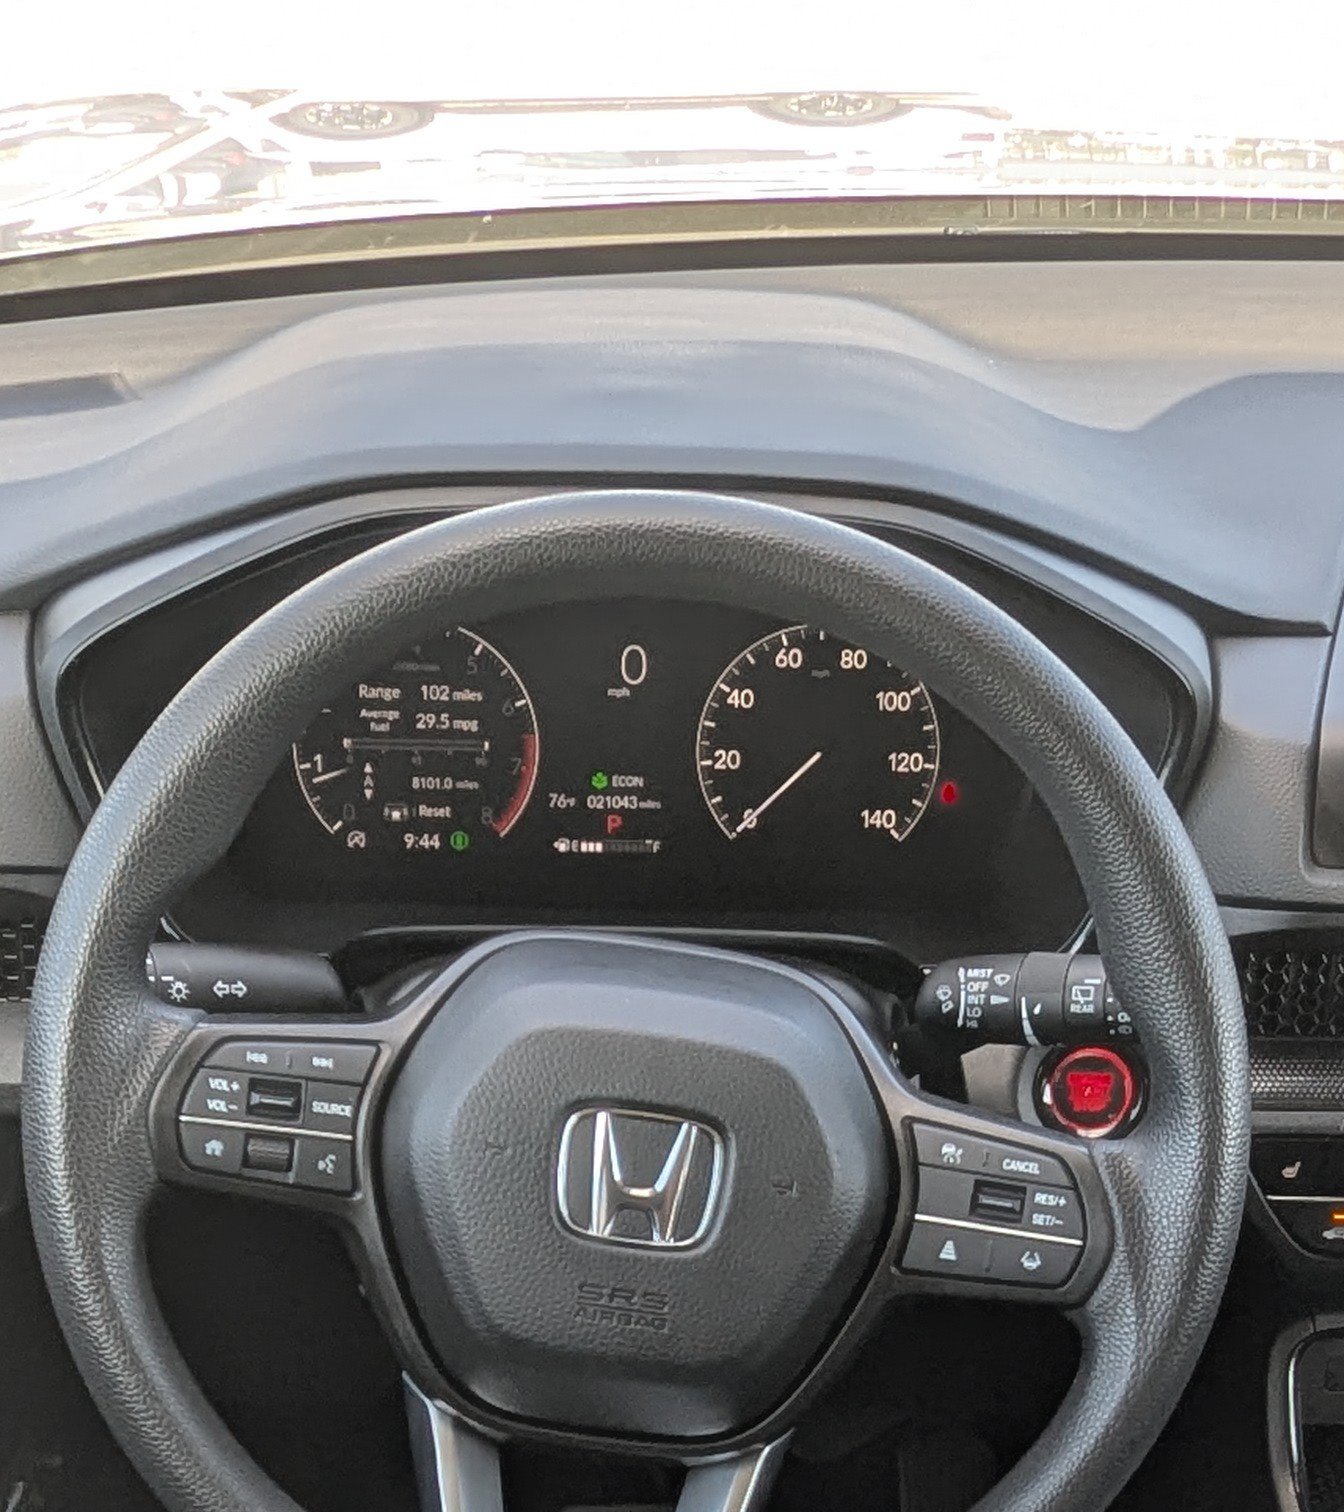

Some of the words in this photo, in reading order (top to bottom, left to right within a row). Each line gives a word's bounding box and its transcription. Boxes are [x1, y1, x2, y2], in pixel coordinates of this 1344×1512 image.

[621, 644, 647, 685] 0
[775, 648, 803, 669] 60
[840, 649, 868, 670] 80
[359, 684, 401, 701] Range
[420, 685, 450, 701] 102
[452, 688, 483, 702] miles
[607, 687, 630, 699] mph
[727, 688, 755, 709] 40
[876, 691, 911, 712] 100
[359, 708, 400, 721] Average
[416, 713, 450, 730] 29.5
[453, 719, 479, 733] mpg
[370, 721, 390, 732] fuel
[714, 750, 741, 770] 20
[888, 753, 924, 773] 120
[412, 776, 453, 790] 8101.0
[612, 775, 644, 787] ECON
[586, 795, 638, 809] 021043
[419, 804, 451, 819] Reset
[861, 809, 896, 828] 140
[607, 814, 623, 834] P
[404, 833, 441, 850] 9:44
[967, 981, 989, 992] OFF
[966, 1006, 982, 1018] LO
[1070, 1003, 1094, 1014] REAR
[312, 1100, 352, 1118] SOURCE
[1002, 1158, 1040, 1175] CANCEL
[576, 1282, 670, 1311] SRS
[573, 1309, 669, 1331] AIRBAG
